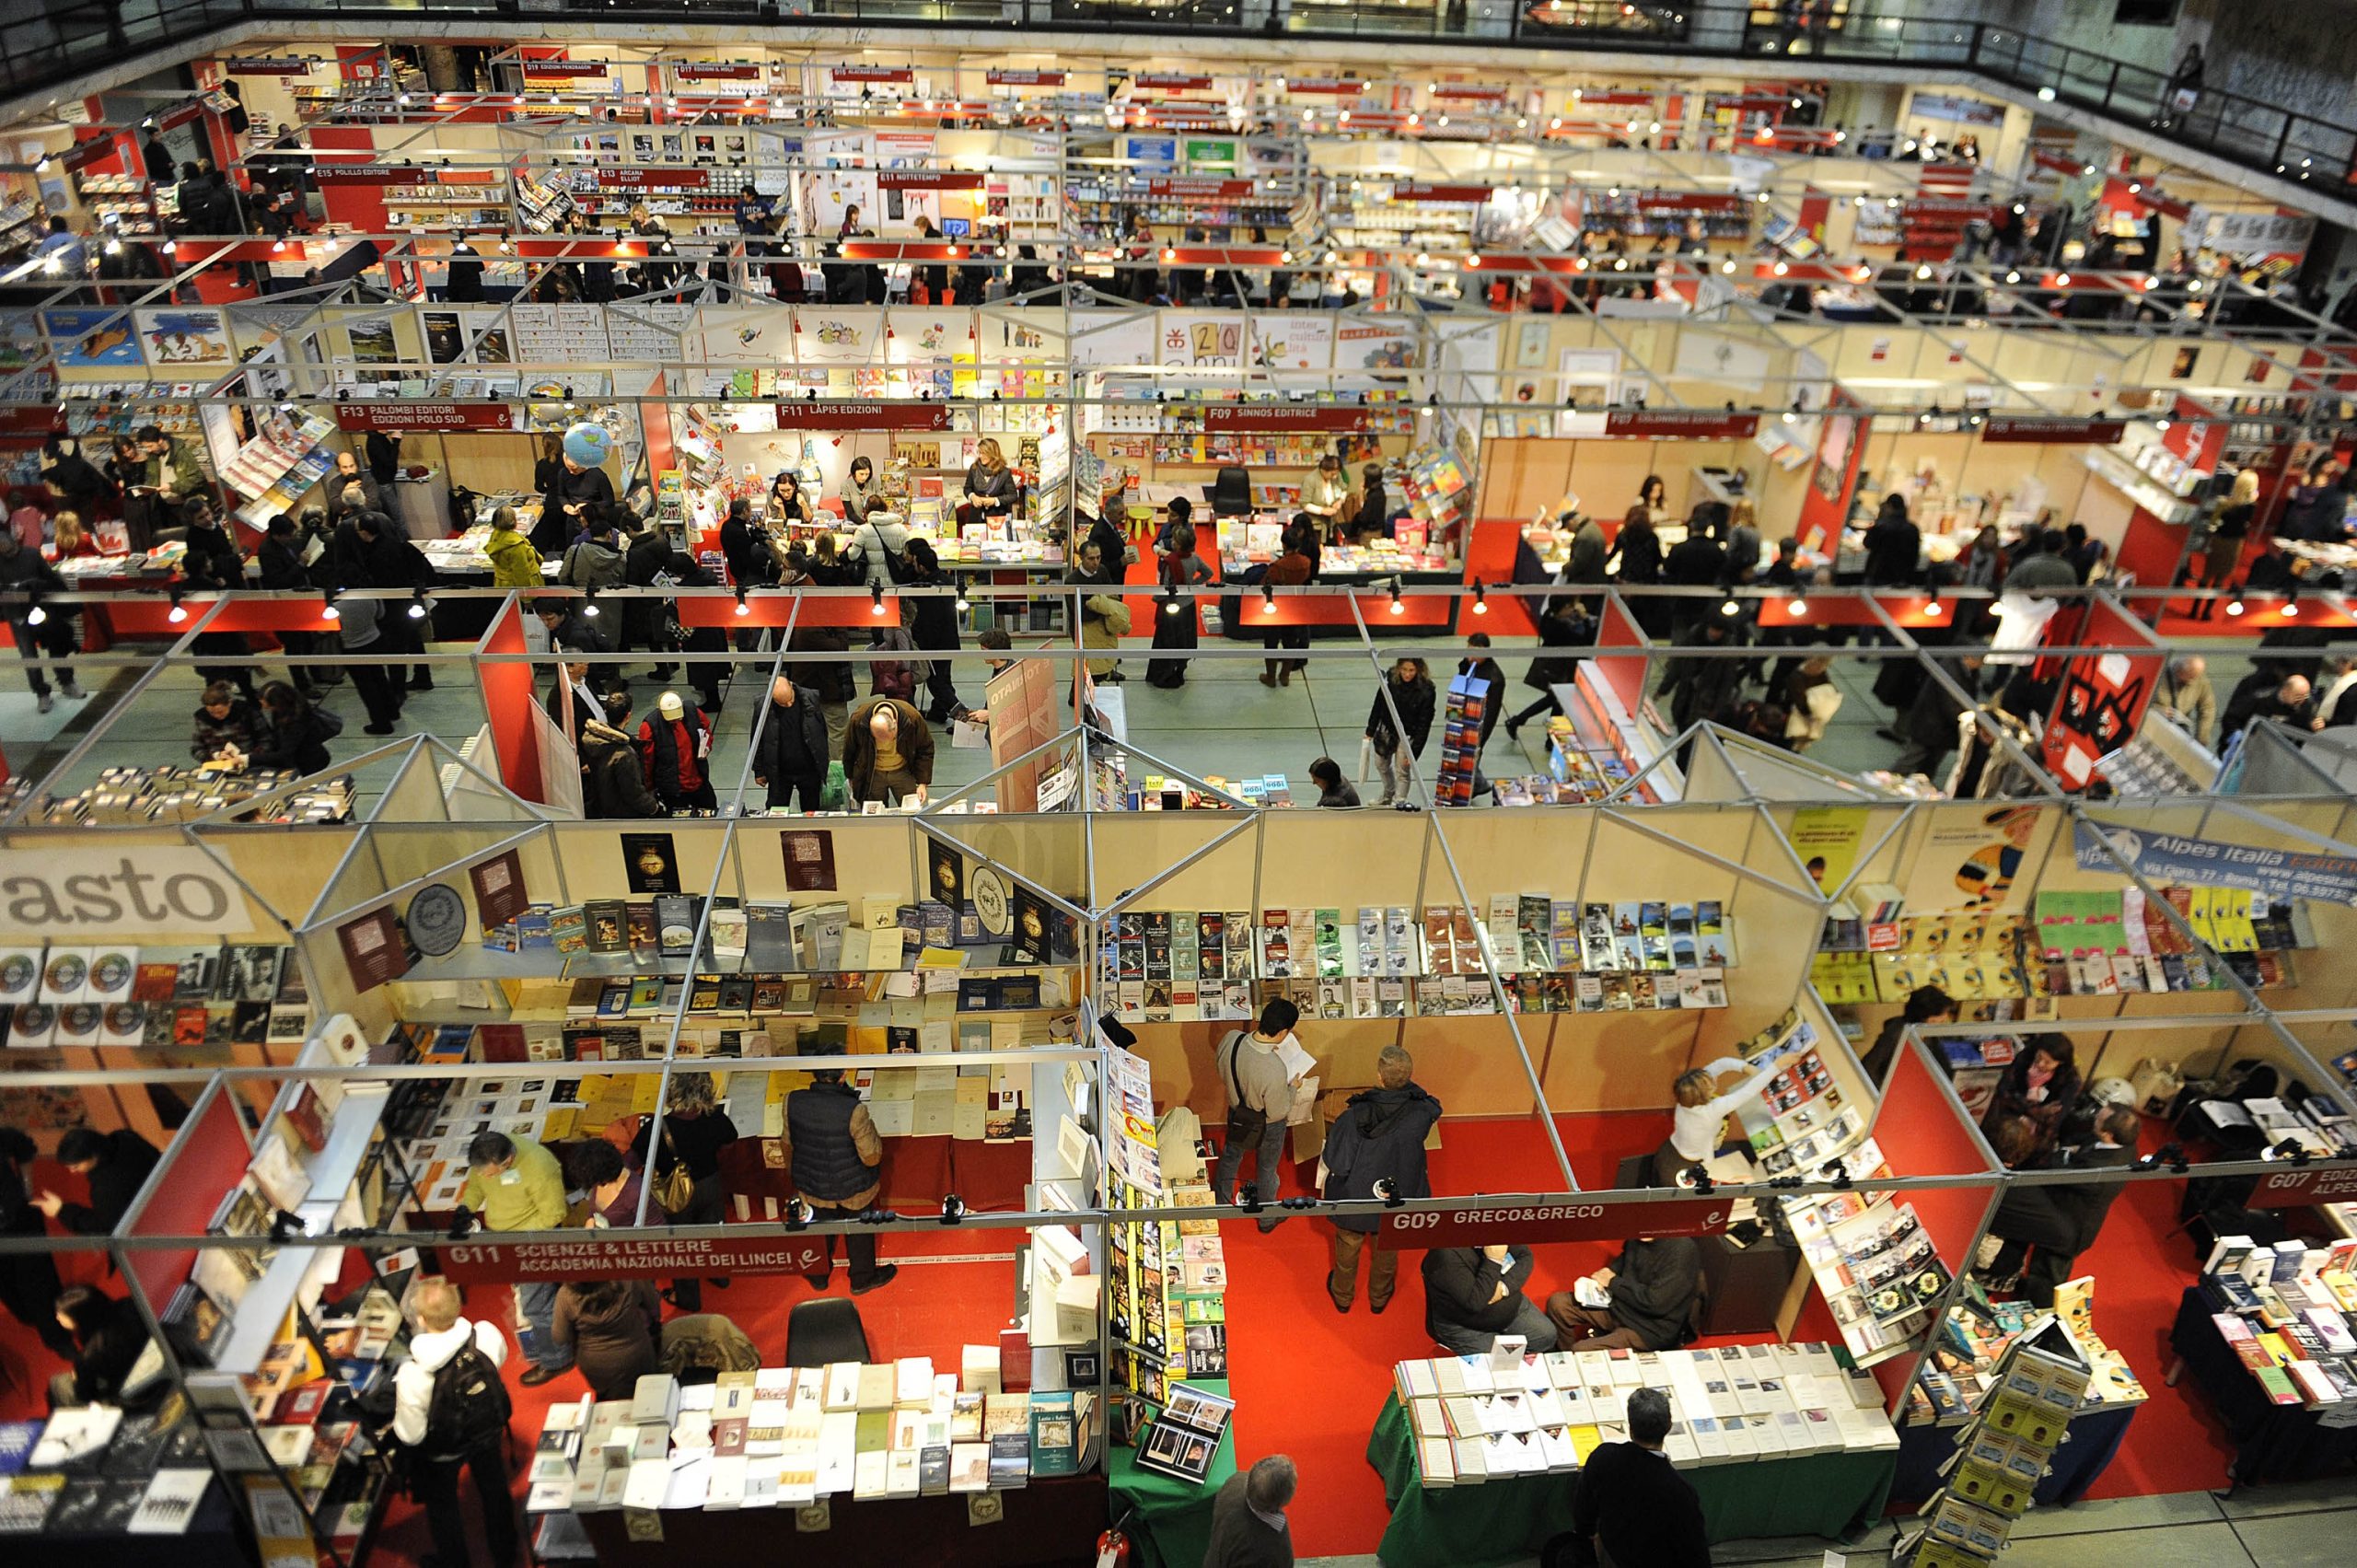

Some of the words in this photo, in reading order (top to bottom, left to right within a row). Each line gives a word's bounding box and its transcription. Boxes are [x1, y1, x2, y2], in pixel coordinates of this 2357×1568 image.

[897, 173, 941, 181] NOTTETEMPO
[341, 407, 365, 418] F13
[370, 405, 414, 414] PALOMBI
[416, 405, 455, 414] EDITORI
[372, 415, 414, 424] EDIZIONI
[417, 414, 443, 424] POLO
[445, 414, 465, 424] SUD
[781, 406, 803, 417] F11
[810, 405, 838, 414] LAPIS
[840, 405, 882, 414] EDIZIONI
[1210, 409, 1232, 420] F09
[1237, 407, 1272, 418] SINNOS
[1274, 407, 1317, 418] EDITRICE
[2153, 834, 2220, 859] Alpes
[2223, 845, 2285, 867] Italia
[1, 858, 229, 925] asto
[2267, 1172, 2312, 1190] G07
[1392, 1212, 1440, 1230] G09
[1453, 1204, 1604, 1225] GRECO&GRECO
[449, 1247, 501, 1264] G11
[514, 1243, 602, 1259] SCIENZE
[604, 1243, 619, 1256] &
[624, 1240, 712, 1256] LETTERE
[519, 1256, 613, 1274] ACCADEMIA
[615, 1254, 707, 1271] NAZIONALE
[710, 1253, 737, 1267] DEI
[740, 1252, 792, 1267] LINCEI
